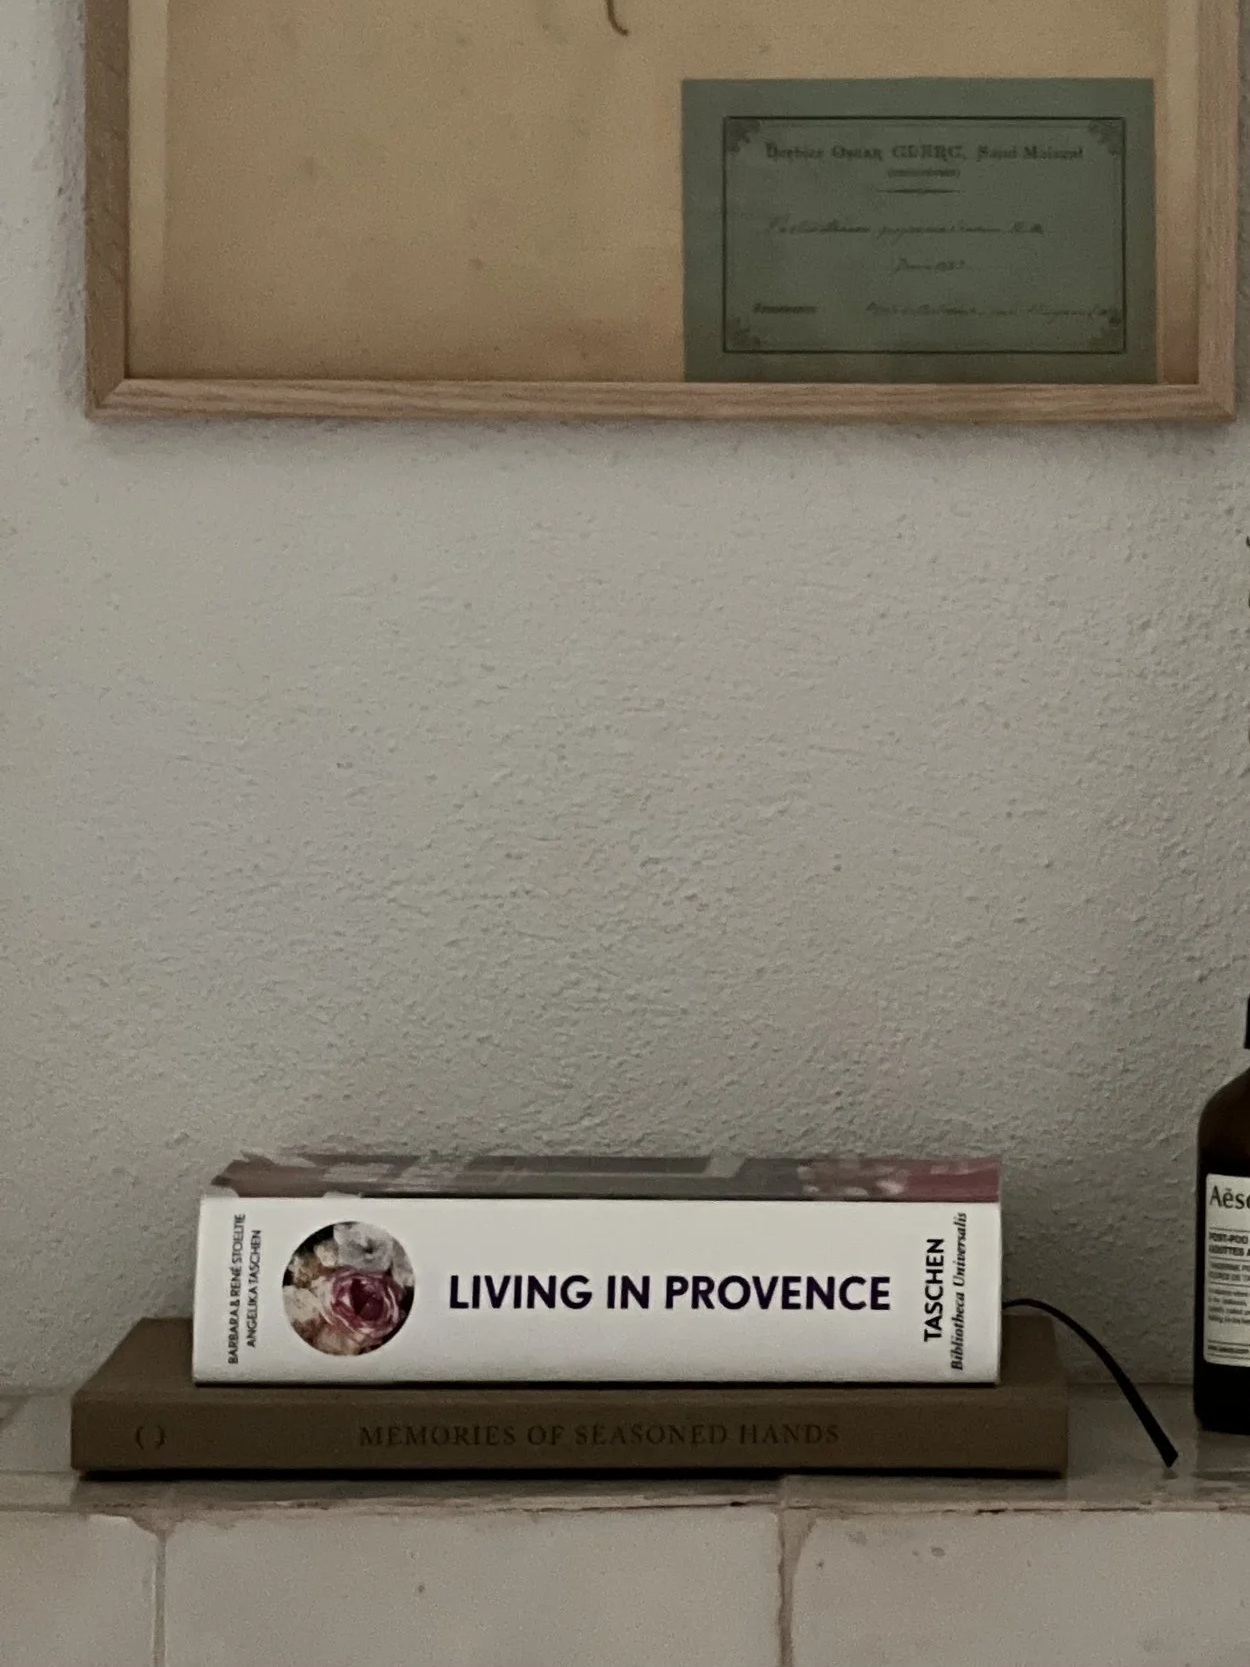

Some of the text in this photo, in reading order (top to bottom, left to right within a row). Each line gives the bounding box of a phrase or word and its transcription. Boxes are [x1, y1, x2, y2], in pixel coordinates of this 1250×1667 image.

[232, 1213, 246, 1265] STOELTIE
[229, 1267, 242, 1297] RENÉ
[246, 1230, 262, 1348] ANGELIKA TASCHEN
[449, 1274, 891, 1311] LIVING IN PROVENCE
[923, 1238, 945, 1343] TASCHEN
[950, 1212, 968, 1371] Bibliotheca Universalis
[228, 1311, 241, 1364] BARBARA
[359, 1422, 841, 1448] MEMORIES OF SEASONED HANDS
